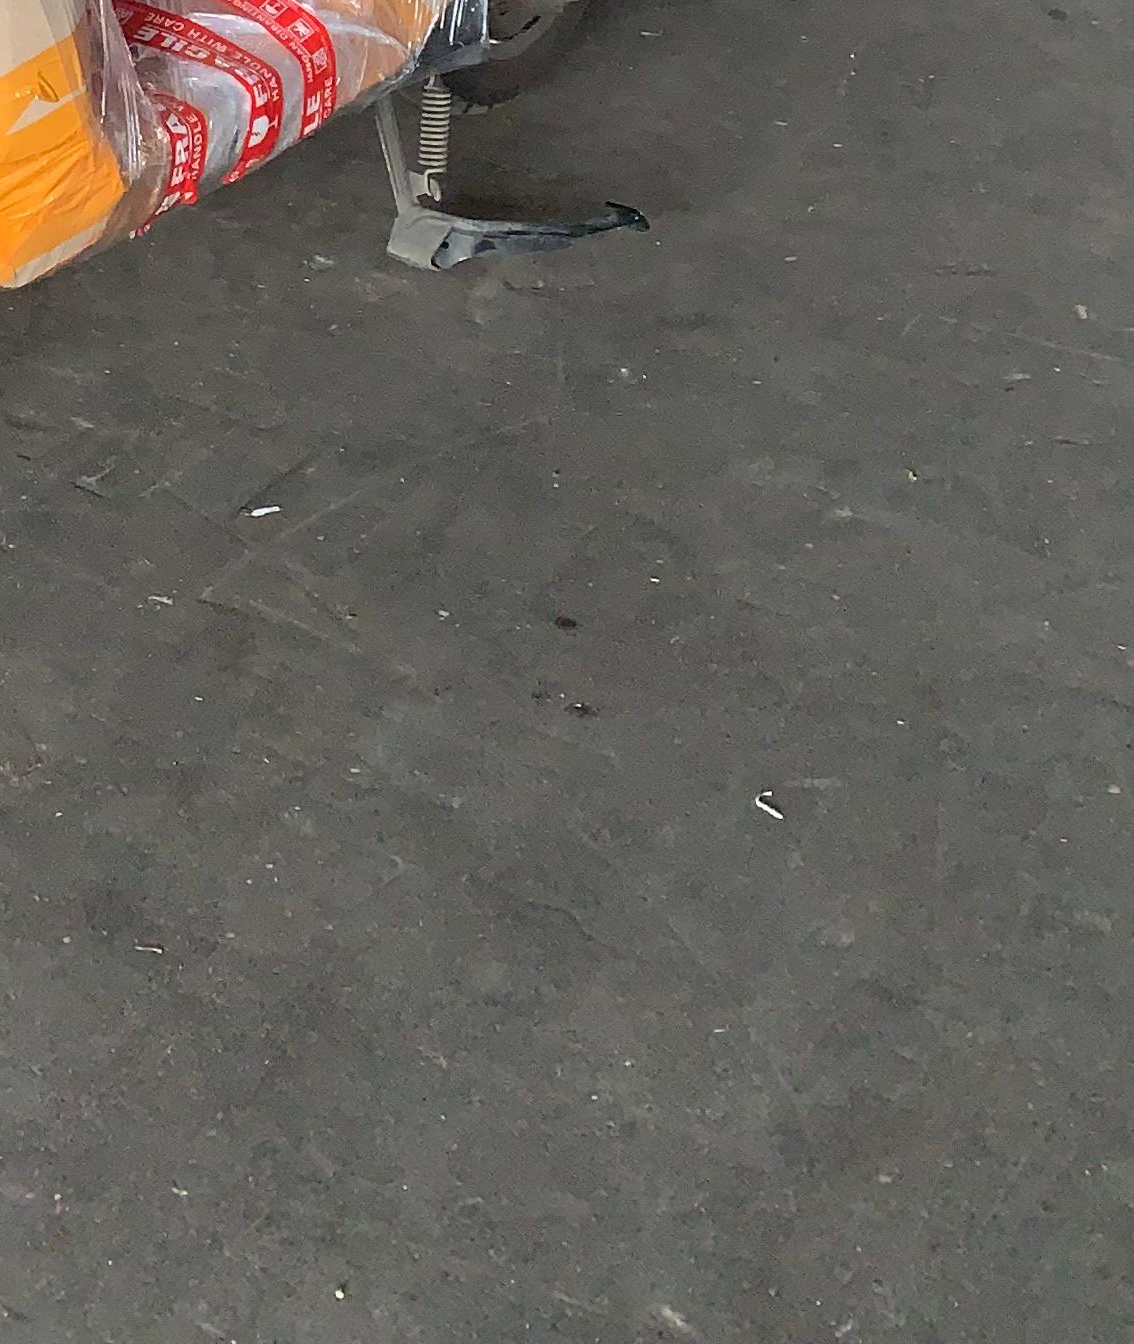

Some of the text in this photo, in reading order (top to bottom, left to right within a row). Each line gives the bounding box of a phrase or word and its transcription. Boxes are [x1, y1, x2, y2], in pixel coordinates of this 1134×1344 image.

[144, 13, 280, 102] HANDLE WITH CARE
